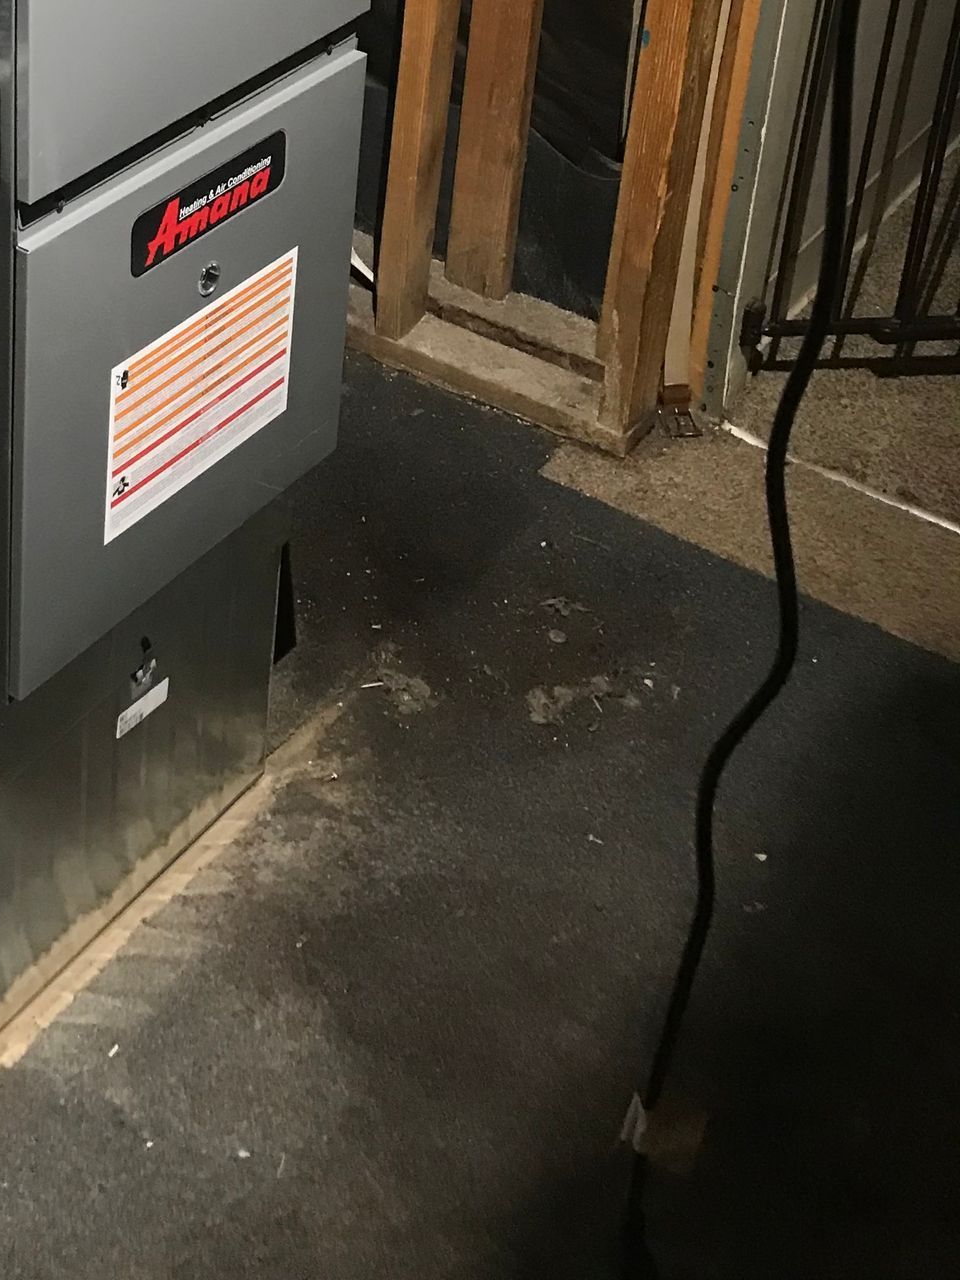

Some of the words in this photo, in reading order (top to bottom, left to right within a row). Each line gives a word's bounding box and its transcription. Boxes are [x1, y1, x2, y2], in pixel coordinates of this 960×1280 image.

[144, 167, 271, 267] Amana
[179, 196, 207, 219] Heating
[208, 189, 215, 199] &
[215, 181, 226, 197] Air
[227, 155, 272, 188] Conditioning
